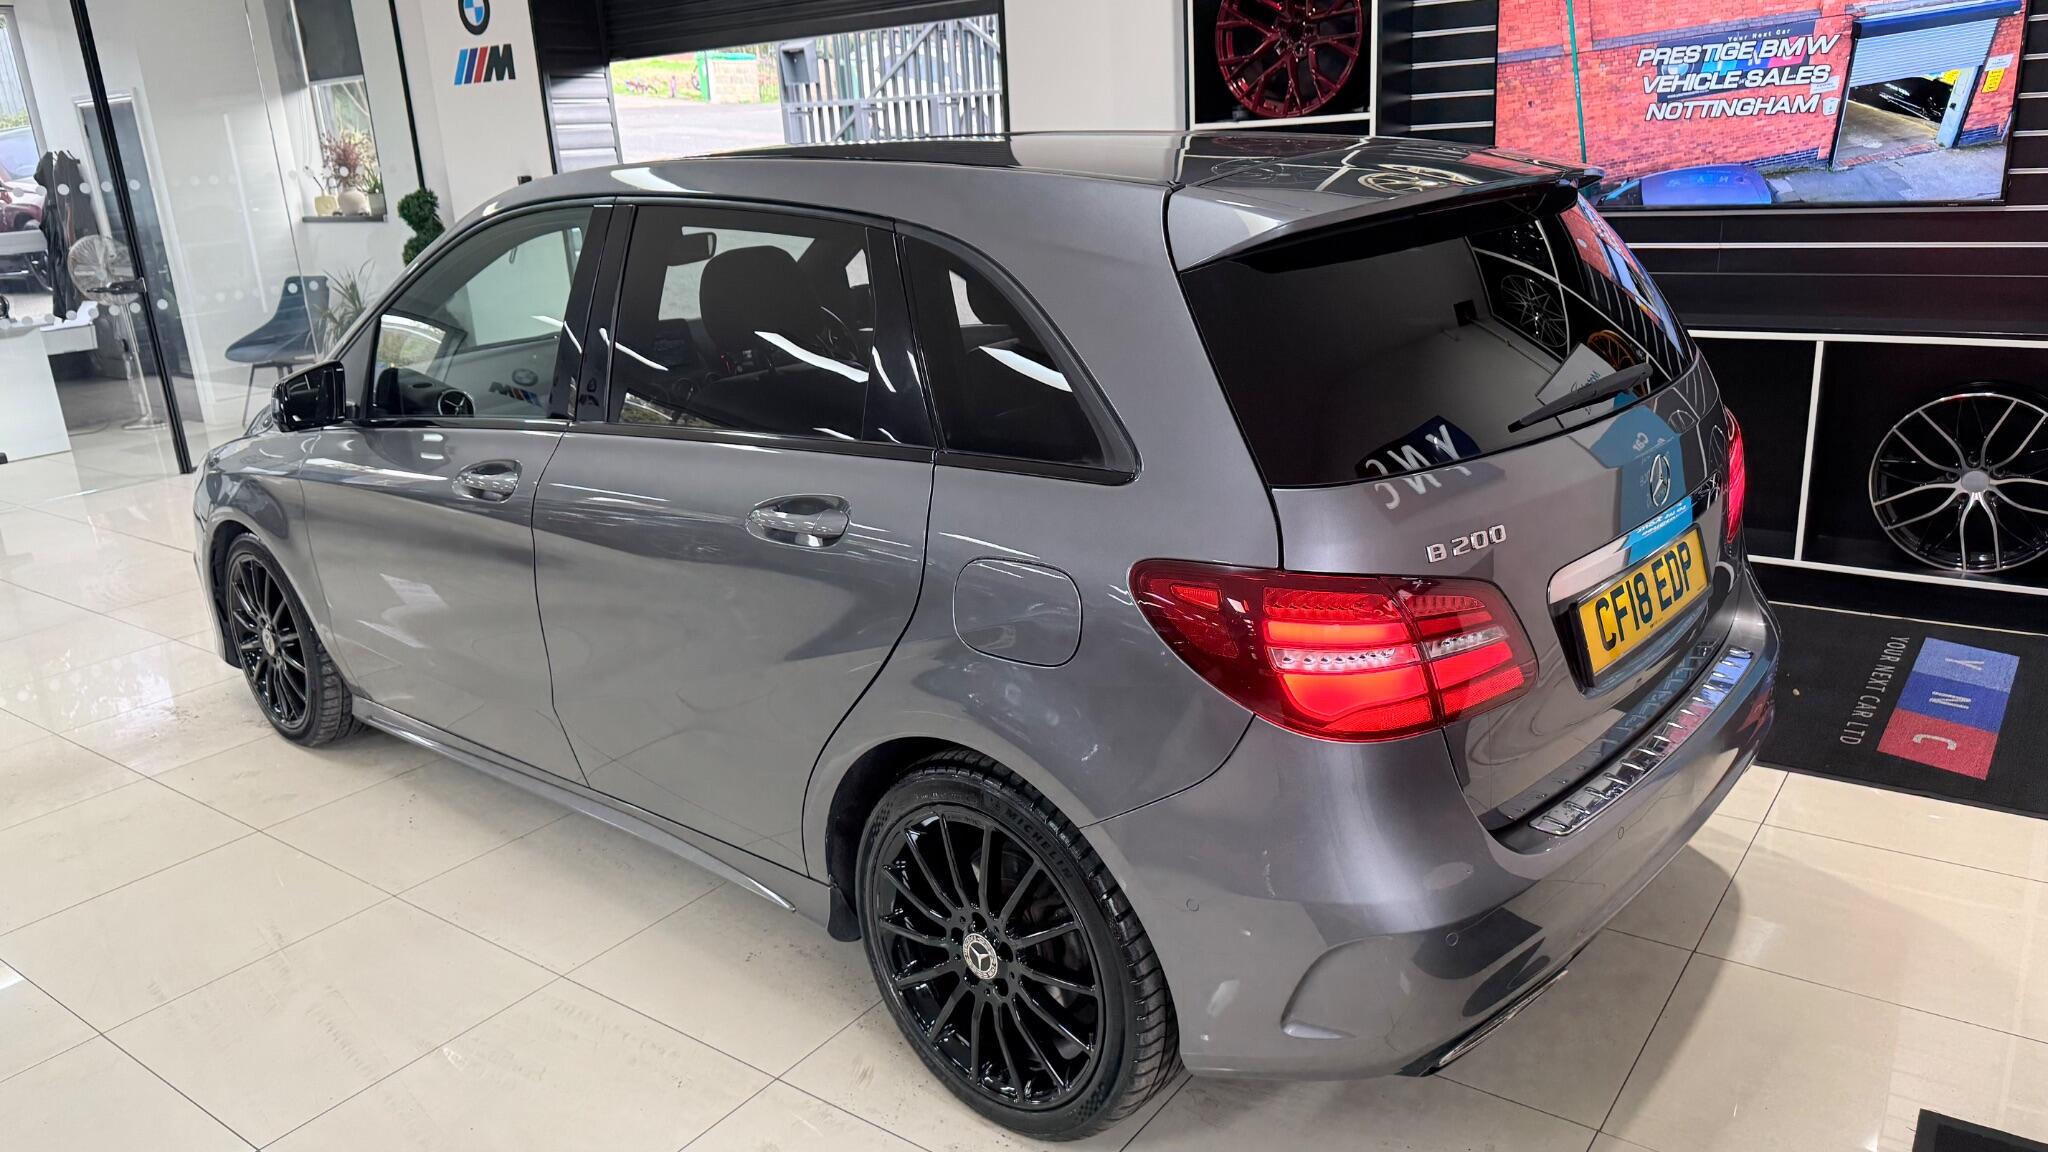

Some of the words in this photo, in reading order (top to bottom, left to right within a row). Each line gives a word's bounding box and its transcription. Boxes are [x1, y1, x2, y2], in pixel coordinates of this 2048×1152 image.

[1636, 41, 1757, 67] PRESTIGE
[1758, 34, 1840, 59] BMW
[1643, 70, 1743, 94] VEHICLE
[1745, 64, 1831, 88] SALES
[1645, 93, 1821, 121] NOTTINGHAM
[1425, 543, 1448, 563] B
[1451, 524, 1507, 557] 200
[1595, 572, 1654, 652] CF18
[1651, 541, 1692, 613] EDP
[1880, 636, 1911, 662] YOUR
[1865, 664, 1896, 693] NEXT
[1851, 695, 1881, 719] CAR
[1839, 721, 1869, 745] LTD
[1005, 808, 1074, 880] MICHELIN
